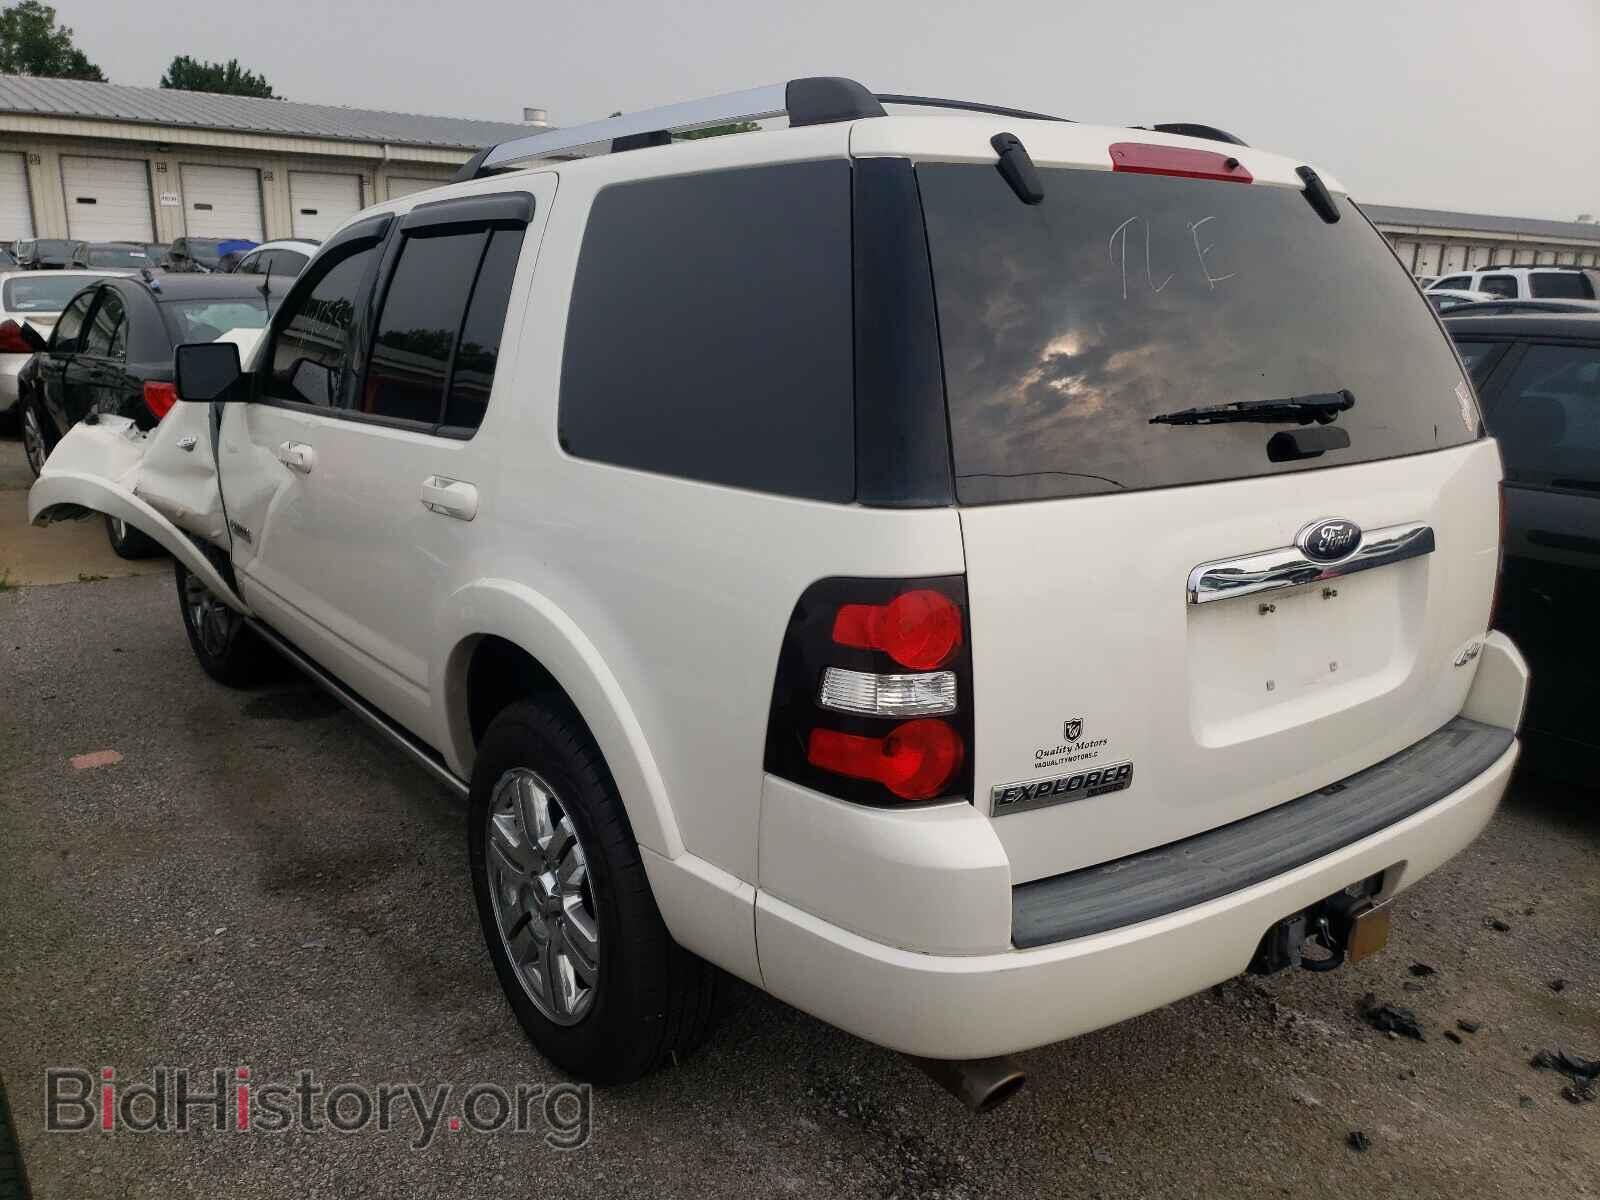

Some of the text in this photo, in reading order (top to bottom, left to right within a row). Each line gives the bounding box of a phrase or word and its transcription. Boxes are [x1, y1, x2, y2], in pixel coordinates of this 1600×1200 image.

[1318, 525, 1353, 552] Ford
[1035, 737, 1108, 760] Quality Motors
[1000, 763, 1131, 805] EXPLORER
